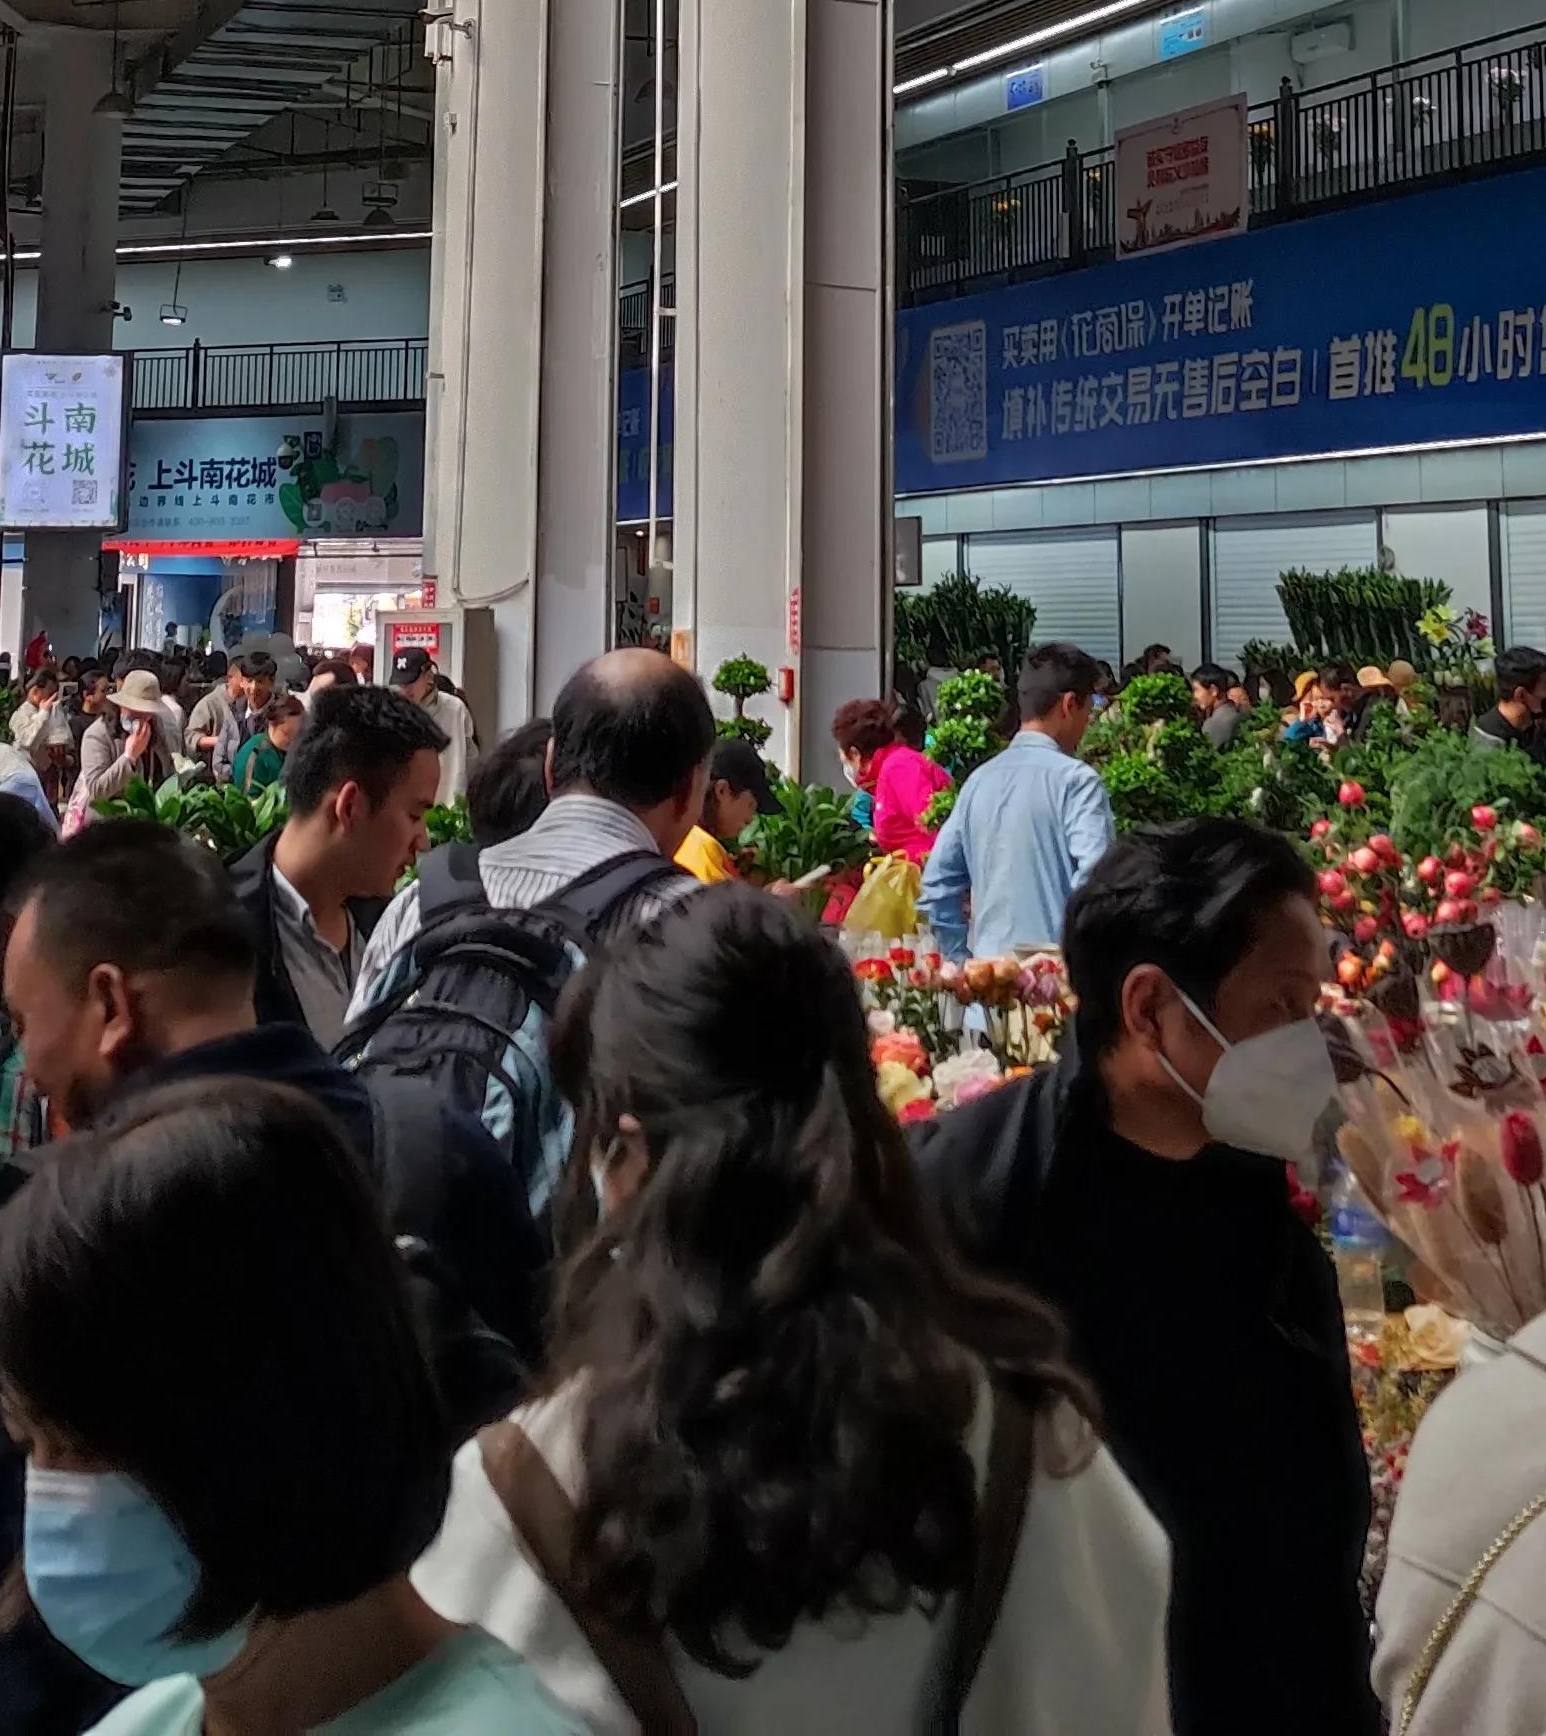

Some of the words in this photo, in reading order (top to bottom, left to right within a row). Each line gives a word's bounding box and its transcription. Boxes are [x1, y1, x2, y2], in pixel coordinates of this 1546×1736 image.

[24, 402, 96, 435] 斗南
[21, 441, 95, 477] 花城
[147, 457, 277, 491] 上斗南花城
